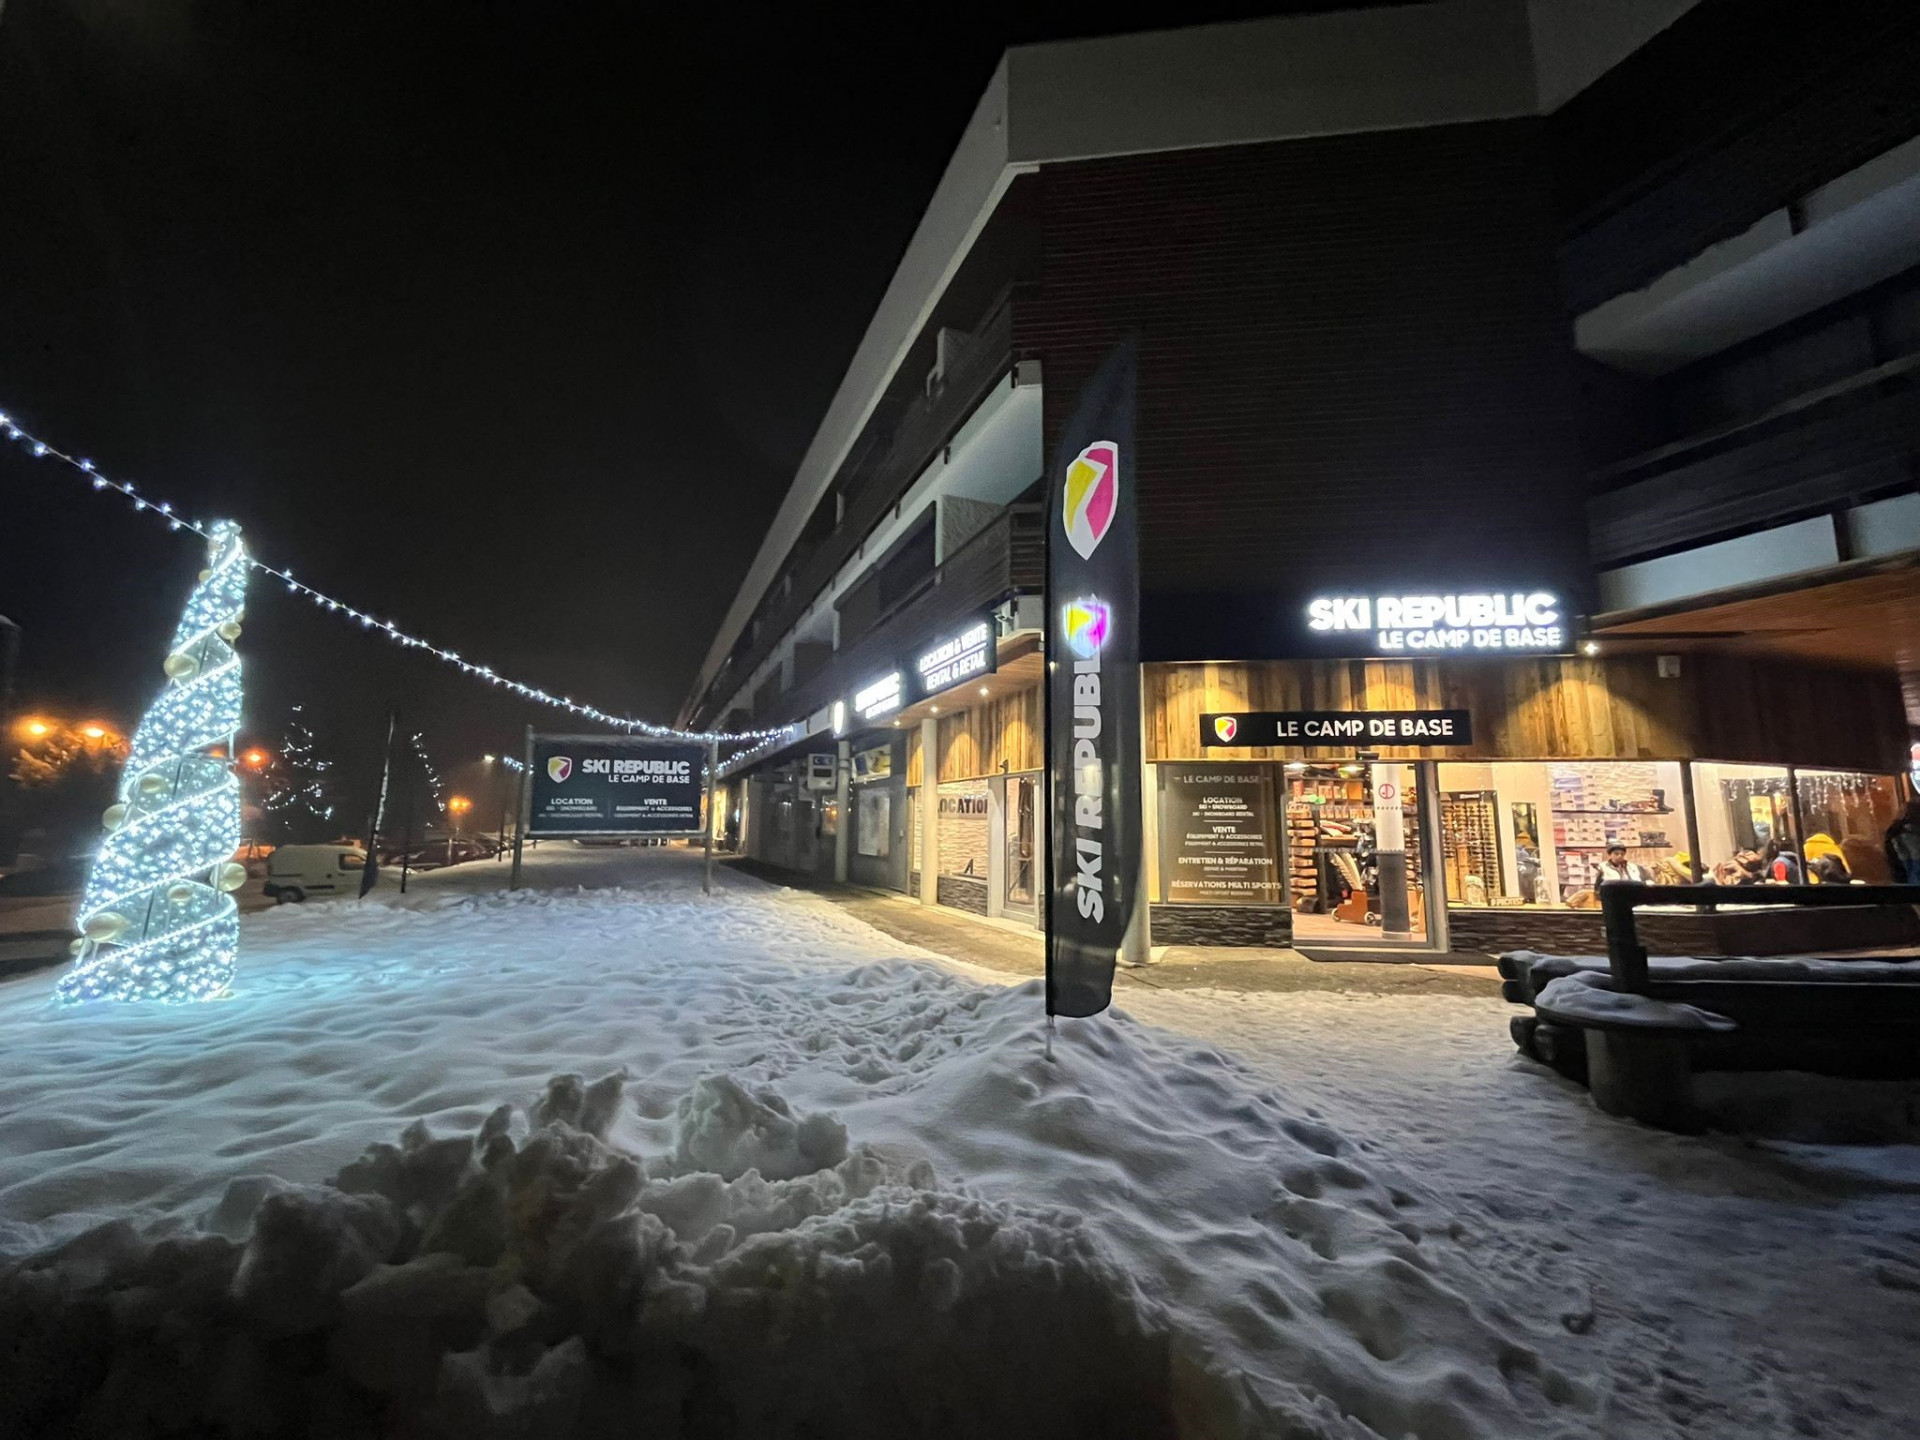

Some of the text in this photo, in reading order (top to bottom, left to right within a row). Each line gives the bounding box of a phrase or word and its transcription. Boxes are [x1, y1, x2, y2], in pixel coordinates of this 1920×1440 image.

[1308, 593, 1559, 630] SKI REPUBLIC
[1379, 627, 1561, 649] LE CAMP DE BASE
[1277, 719, 1453, 737] LE CAMP DE BASE
[1074, 593, 1104, 924] SKI REPUBL
[582, 759, 690, 775] SKI REPUBLIC
[608, 775, 690, 784] LE CAMP DE BASE
[1183, 775, 1260, 784] LE CAMP DE BASE
[938, 798, 988, 814] OCATIO
[1225, 856, 1273, 865] RÉPARATION
[1171, 880, 1282, 890] RÉSERVATIONS MULTI SPORTS
